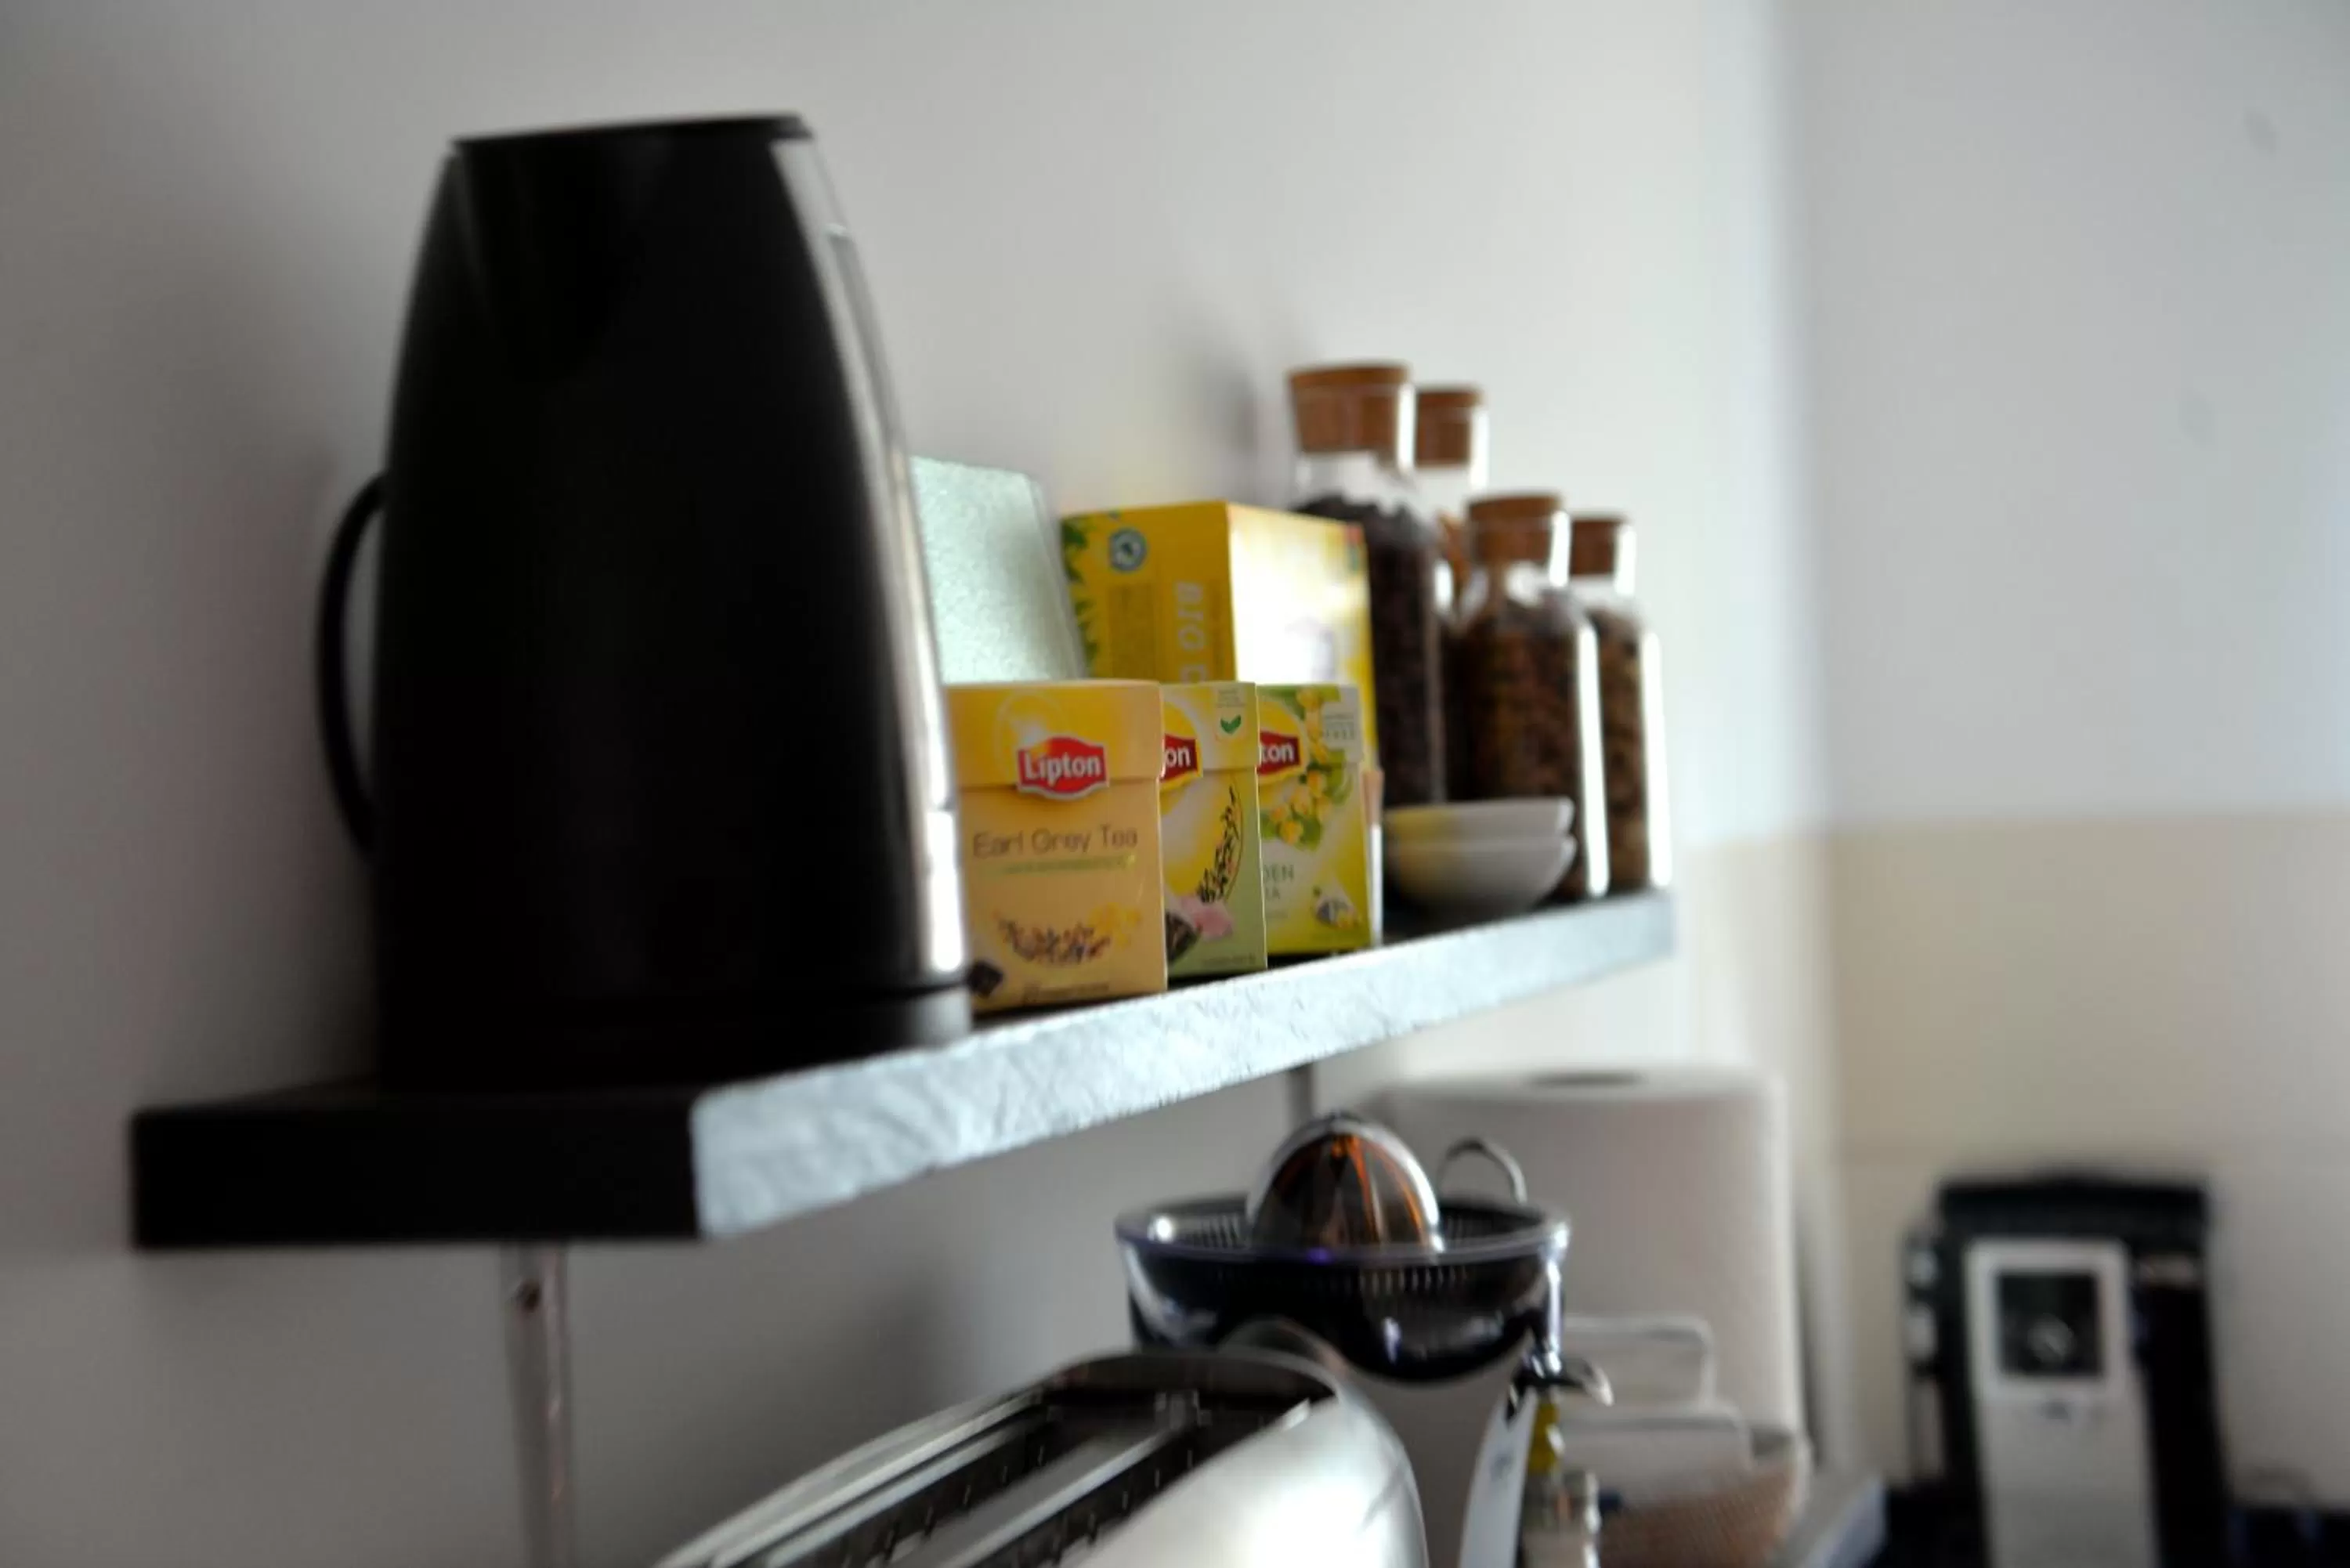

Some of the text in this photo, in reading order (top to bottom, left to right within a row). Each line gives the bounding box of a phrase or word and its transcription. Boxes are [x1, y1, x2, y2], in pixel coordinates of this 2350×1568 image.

[1177, 581, 1206, 652] BIO
[1024, 751, 1101, 786] Lipton
[973, 823, 1138, 858] Earl Grey Tea
